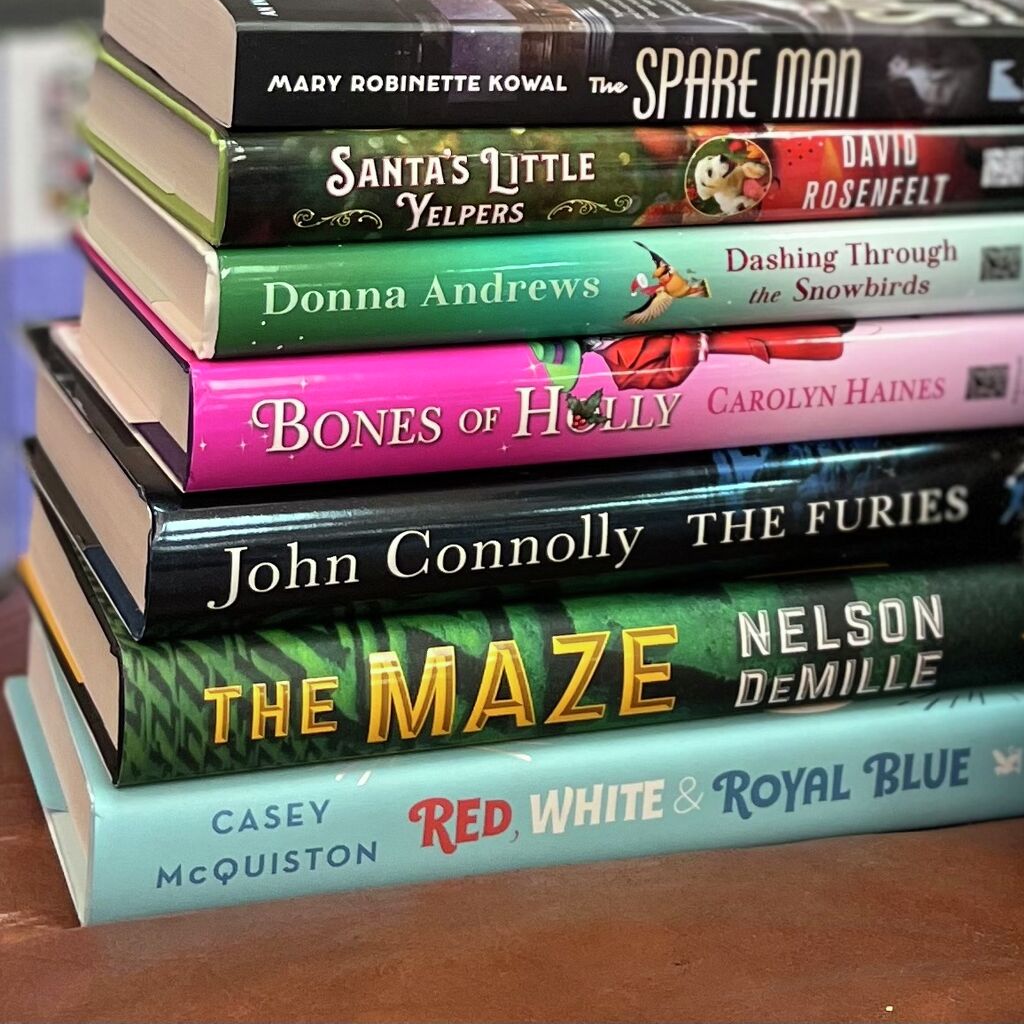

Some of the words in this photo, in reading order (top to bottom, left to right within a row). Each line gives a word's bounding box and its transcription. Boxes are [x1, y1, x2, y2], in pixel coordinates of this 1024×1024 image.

[267, 75, 341, 93] MARY
[350, 74, 481, 93] ROBINETTE
[488, 74, 568, 92] KOWAL
[589, 77, 628, 94] The
[632, 47, 761, 120] SPARE
[771, 48, 862, 120] MAN
[326, 145, 469, 197] SANTA'S
[480, 146, 596, 195] LITTLE
[842, 132, 918, 168] DAVID
[396, 192, 524, 232] YELPERS
[802, 175, 949, 210] ROSENFELT
[725, 244, 839, 273] Dashing
[845, 238, 957, 268] Through
[262, 280, 406, 316] Donna
[419, 271, 600, 308] Andrews
[748, 285, 781, 304] the
[792, 274, 930, 303] Snowbirds
[707, 382, 837, 416] CAROLYN
[844, 376, 946, 407] HAINES
[251, 396, 441, 454] BONES
[458, 406, 501, 434] OF
[687, 504, 786, 547] THE
[805, 484, 969, 535] FURIES
[206, 541, 360, 610] John
[386, 511, 645, 578] Connolly
[737, 593, 944, 659] NELSON
[204, 675, 339, 744] THE
[366, 624, 679, 744] MAZE
[211, 799, 331, 835] CASEY
[408, 796, 520, 855] RED,
[529, 778, 665, 835] WHITE
[673, 775, 705, 815] &
[712, 763, 851, 820] ROYAL
[863, 747, 971, 798] BLUE
[156, 841, 378, 889] McQUISTON
